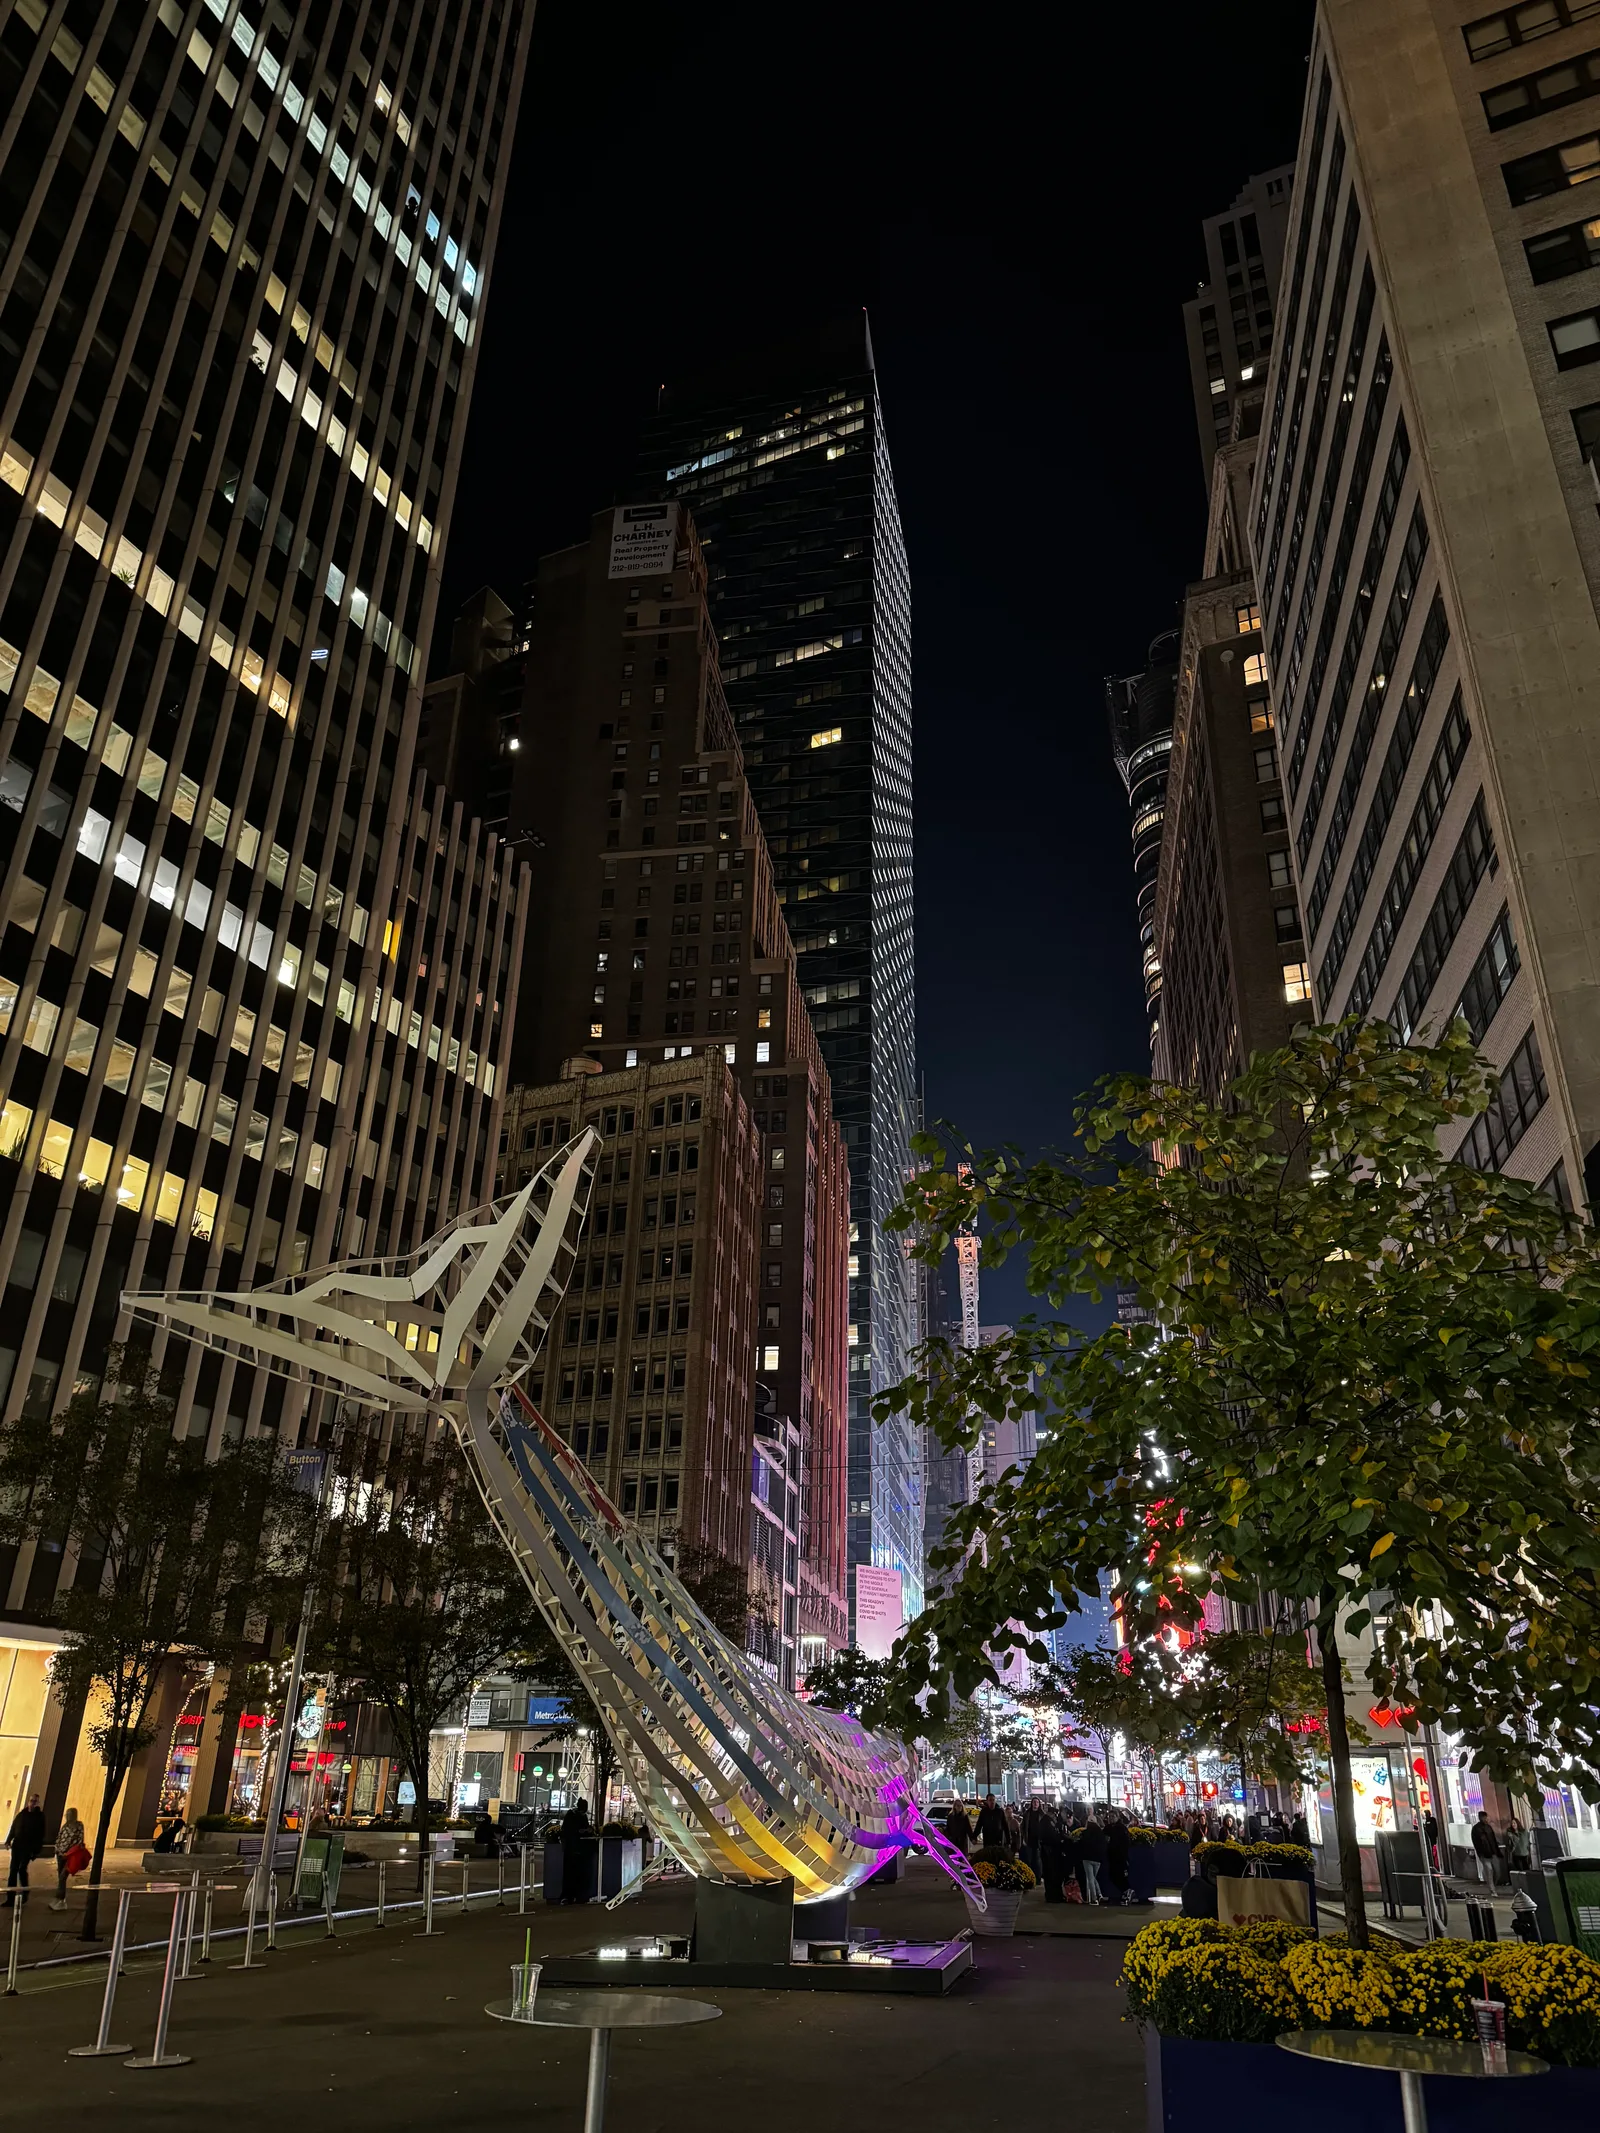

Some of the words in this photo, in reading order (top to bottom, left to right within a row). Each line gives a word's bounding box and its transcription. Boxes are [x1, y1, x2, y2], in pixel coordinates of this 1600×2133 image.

[633, 522, 655, 532] L.H.
[613, 529, 673, 542] CHARNEY
[634, 544, 669, 552] Property
[613, 552, 666, 562] Development
[289, 1455, 320, 1464] Button
